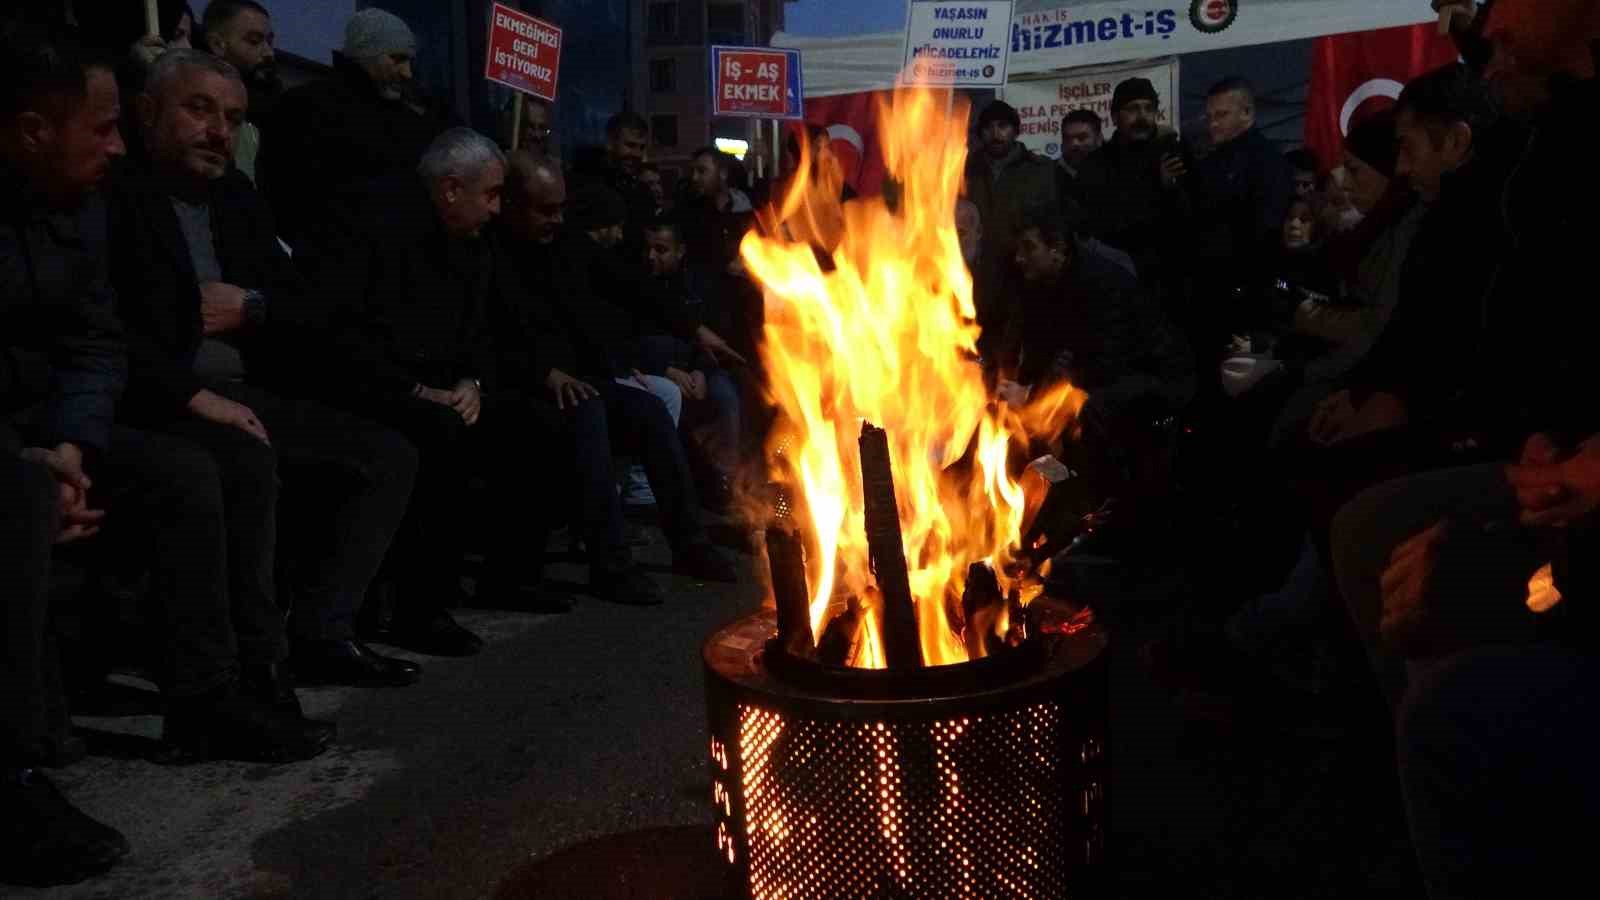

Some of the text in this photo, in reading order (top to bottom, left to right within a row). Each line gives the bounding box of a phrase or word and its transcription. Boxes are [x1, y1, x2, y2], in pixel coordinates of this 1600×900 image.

[934, 7, 988, 22] YAŞASIN
[495, 12, 559, 48] EKMEĞİMİZİ
[932, 27, 984, 40] ONURLU
[1011, 9, 1176, 51] hizmet-iş
[512, 38, 538, 58] GERİ
[913, 44, 1001, 59] MÜCADELEMİZ
[494, 46, 553, 82] İSTİYORUZ
[725, 56, 742, 82] İŞ
[756, 61, 780, 82] AŞ
[723, 83, 781, 101] EKMEK
[1059, 81, 1112, 100] İŞÇİLER
[1018, 103, 1047, 118] SLA
[1019, 119, 1060, 135] RENİŞ
